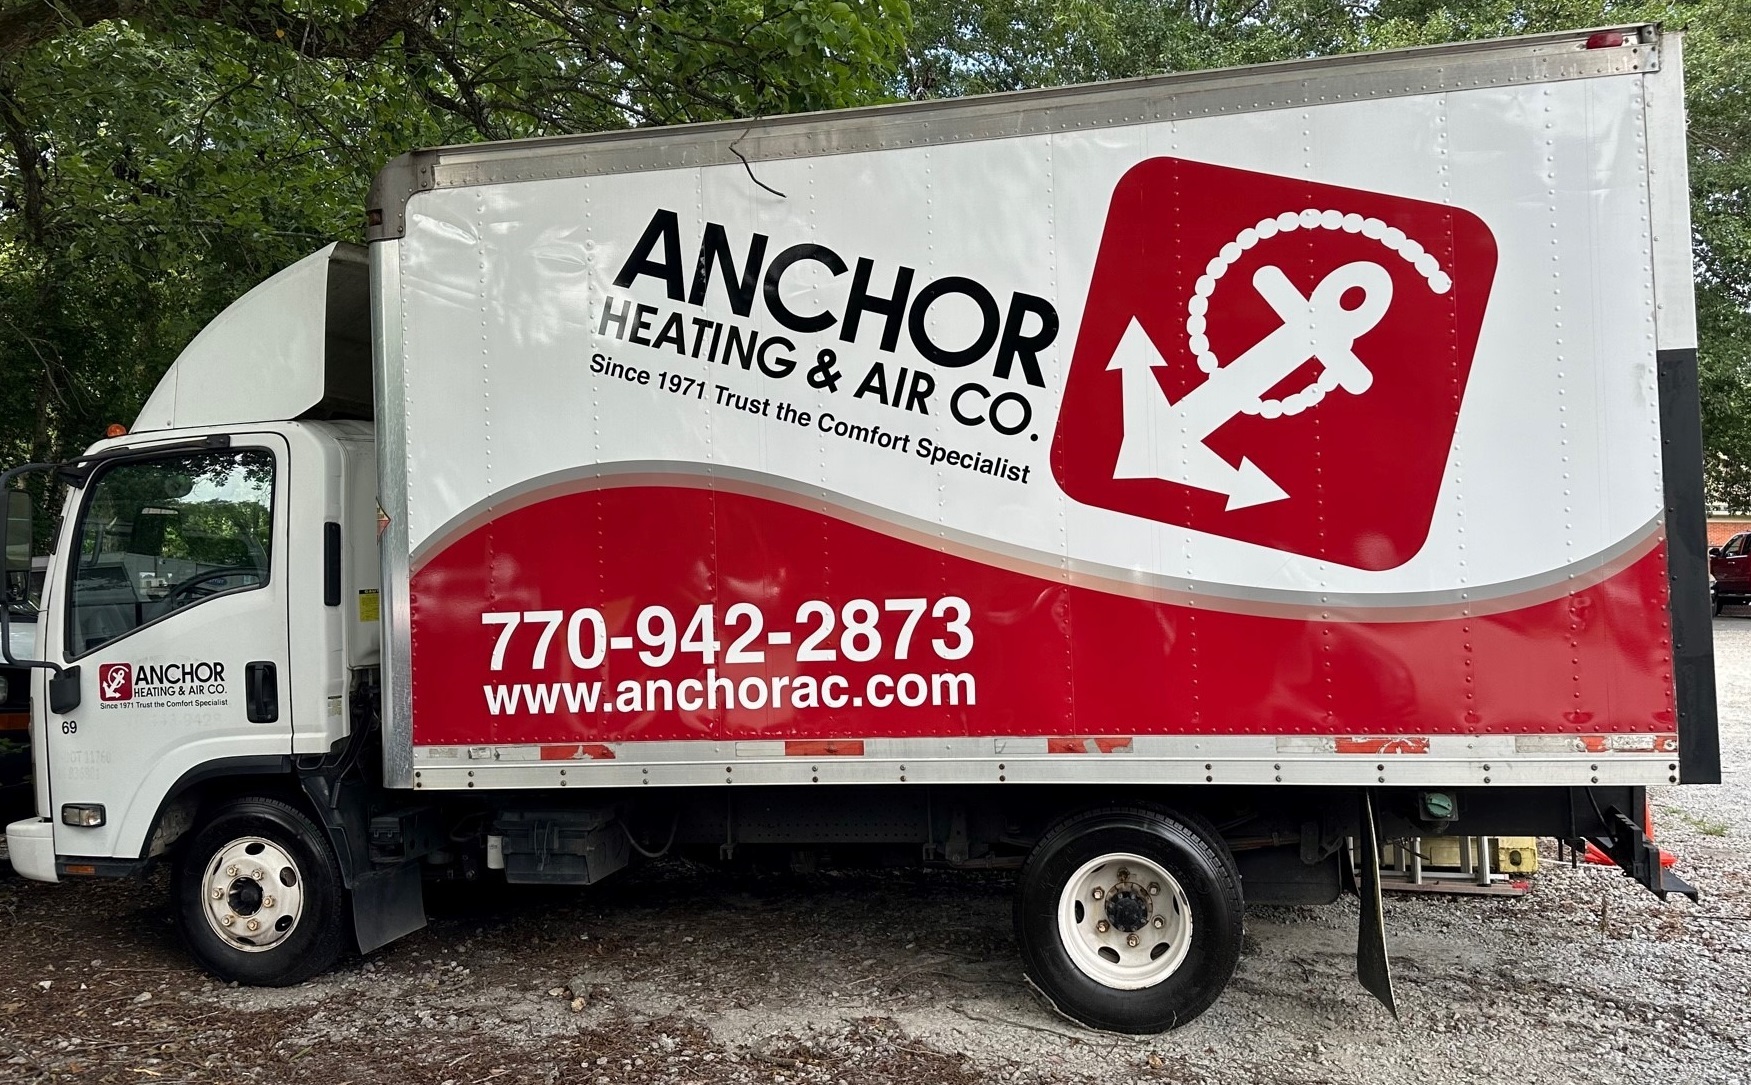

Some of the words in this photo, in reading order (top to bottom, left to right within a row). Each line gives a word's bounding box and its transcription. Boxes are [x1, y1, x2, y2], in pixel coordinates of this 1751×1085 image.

[612, 208, 1060, 388] ANCHOR
[598, 295, 798, 379] HEATING
[807, 349, 842, 394] &
[853, 361, 936, 416] AIR
[949, 382, 1039, 442] CO.
[589, 353, 651, 385] Since
[658, 371, 706, 400] 1971
[714, 384, 771, 417] Trust
[776, 402, 812, 427] the
[817, 412, 911, 454] Comfort
[915, 437, 1031, 485] Specialist
[481, 596, 975, 671] 770-942-2873
[133, 685, 176, 698] HEATING
[178, 685, 186, 696] &
[188, 684, 205, 696] AIR
[207, 683, 228, 695] CO.
[134, 662, 225, 685] ANCHOR
[483, 668, 977, 715] www.anchorac.com
[61, 720, 78, 734] 69
[100, 702, 119, 710] Since
[119, 701, 134, 709] 1971
[153, 700, 166, 708] the
[166, 700, 194, 708] Comfort
[195, 699, 228, 708] Specialist
